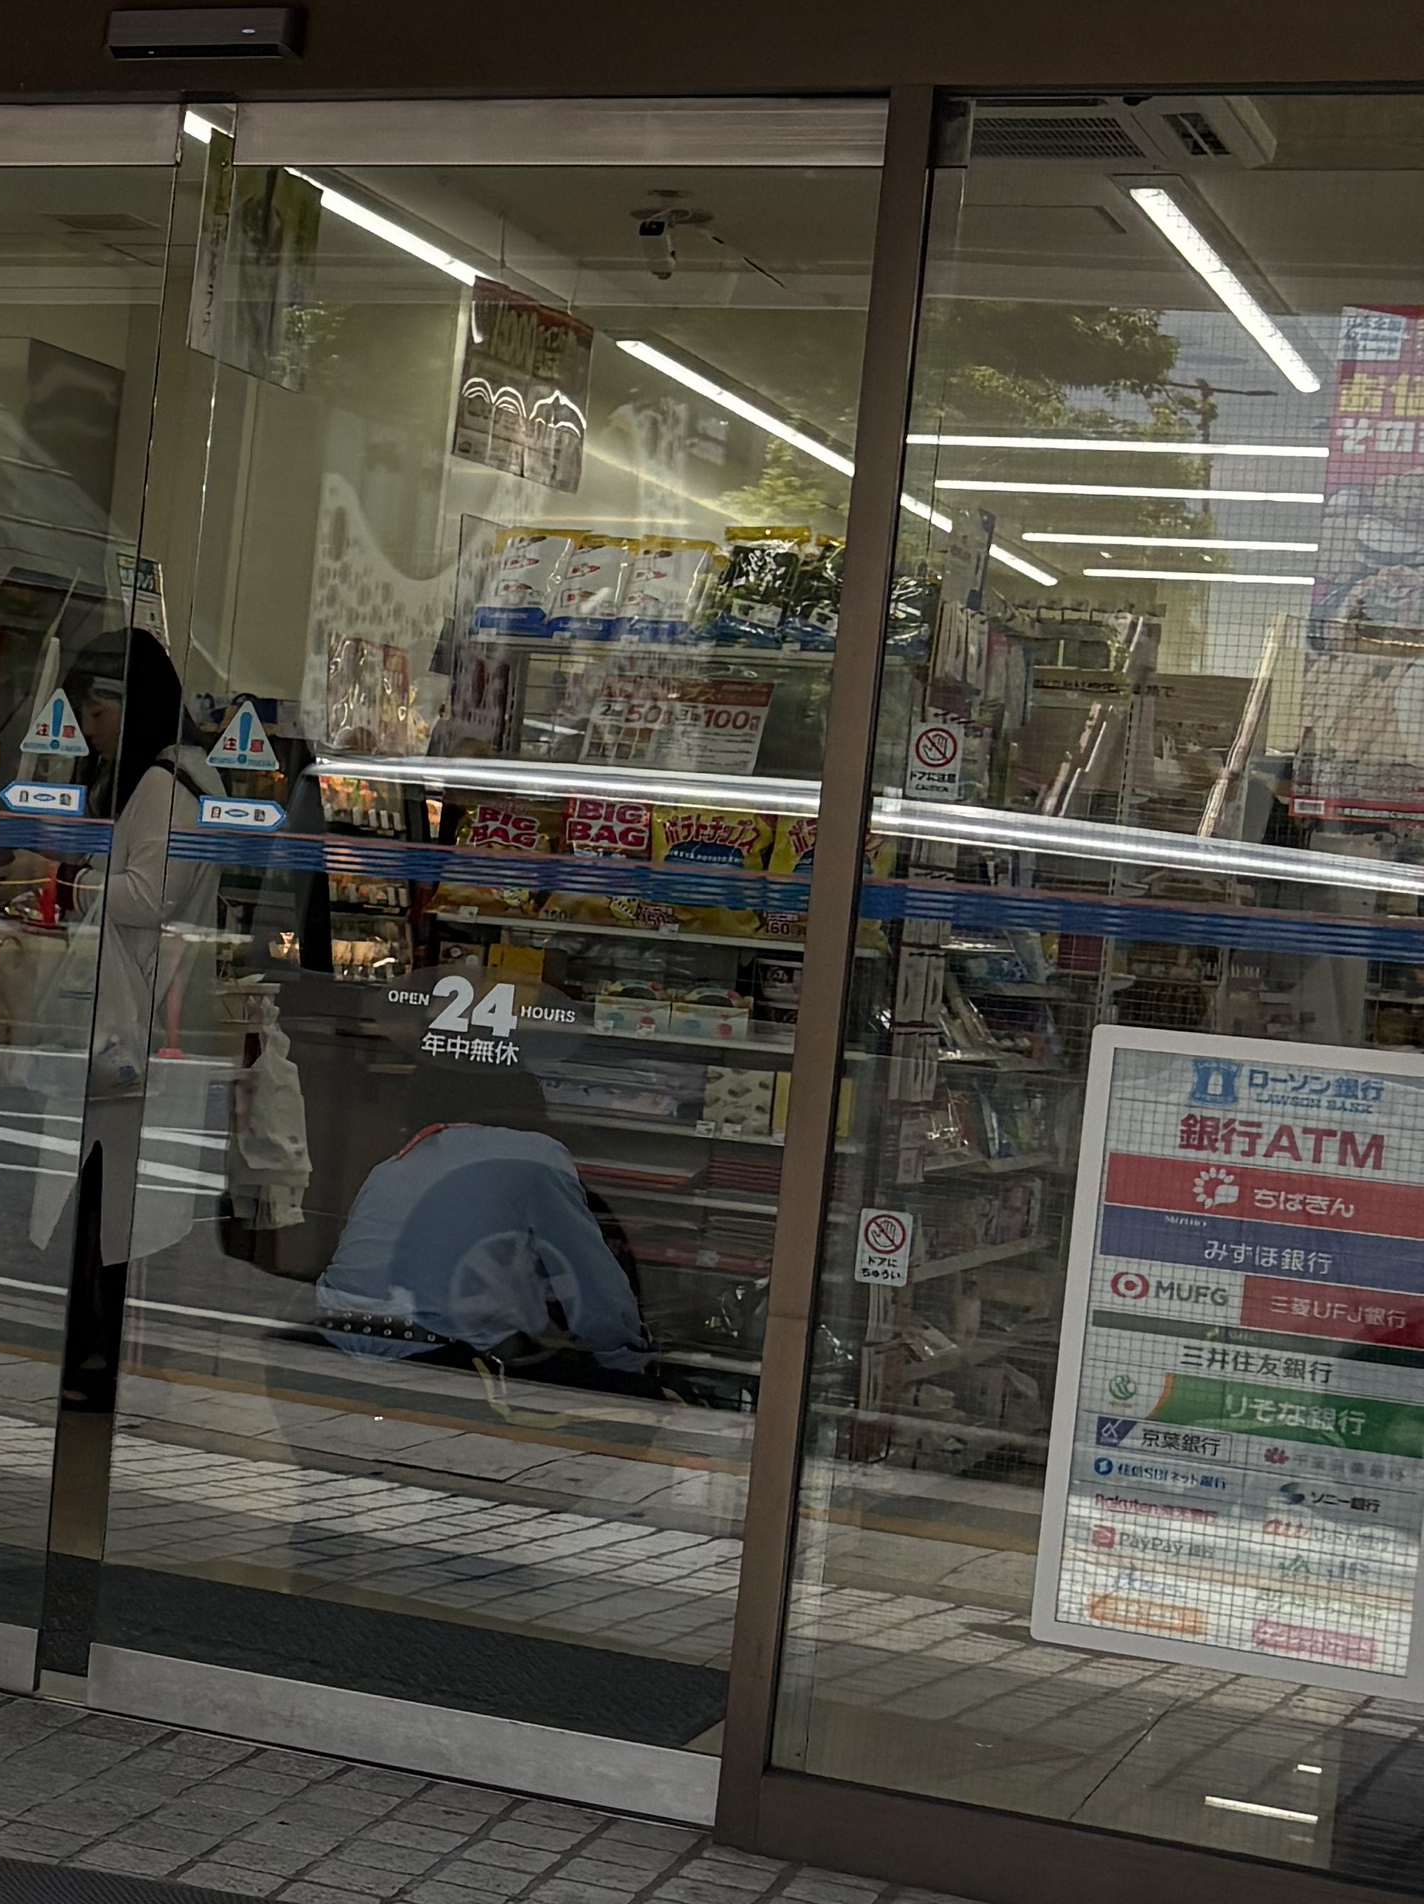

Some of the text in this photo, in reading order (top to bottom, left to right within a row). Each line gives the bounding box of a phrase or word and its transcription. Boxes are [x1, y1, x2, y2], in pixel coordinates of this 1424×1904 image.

[478, 804, 538, 832] BIG
[575, 799, 646, 825] BIG
[467, 823, 539, 849] BAG
[567, 819, 648, 849] BAG
[388, 975, 576, 1036] OPEN 24 HOURS
[421, 1033, 520, 1066] 年中無休
[1248, 1068, 1385, 1103] ローソン銀行
[1177, 1113, 1385, 1171] 銀行ATM
[1252, 1187, 1355, 1219] ちばぎん
[1203, 1240, 1333, 1276] みずほ銀行
[1155, 1279, 1229, 1307] MUFG
[1270, 1296, 1408, 1330] 三菱UFJ銀行
[1179, 1345, 1334, 1384] 三井住友銀行
[1224, 1393, 1367, 1437] りそな銀行
[1141, 1428, 1222, 1457] 京葉銀行
[1310, 1491, 1381, 1514] ソニー銀行
[1119, 1531, 1185, 1557] PayPay
